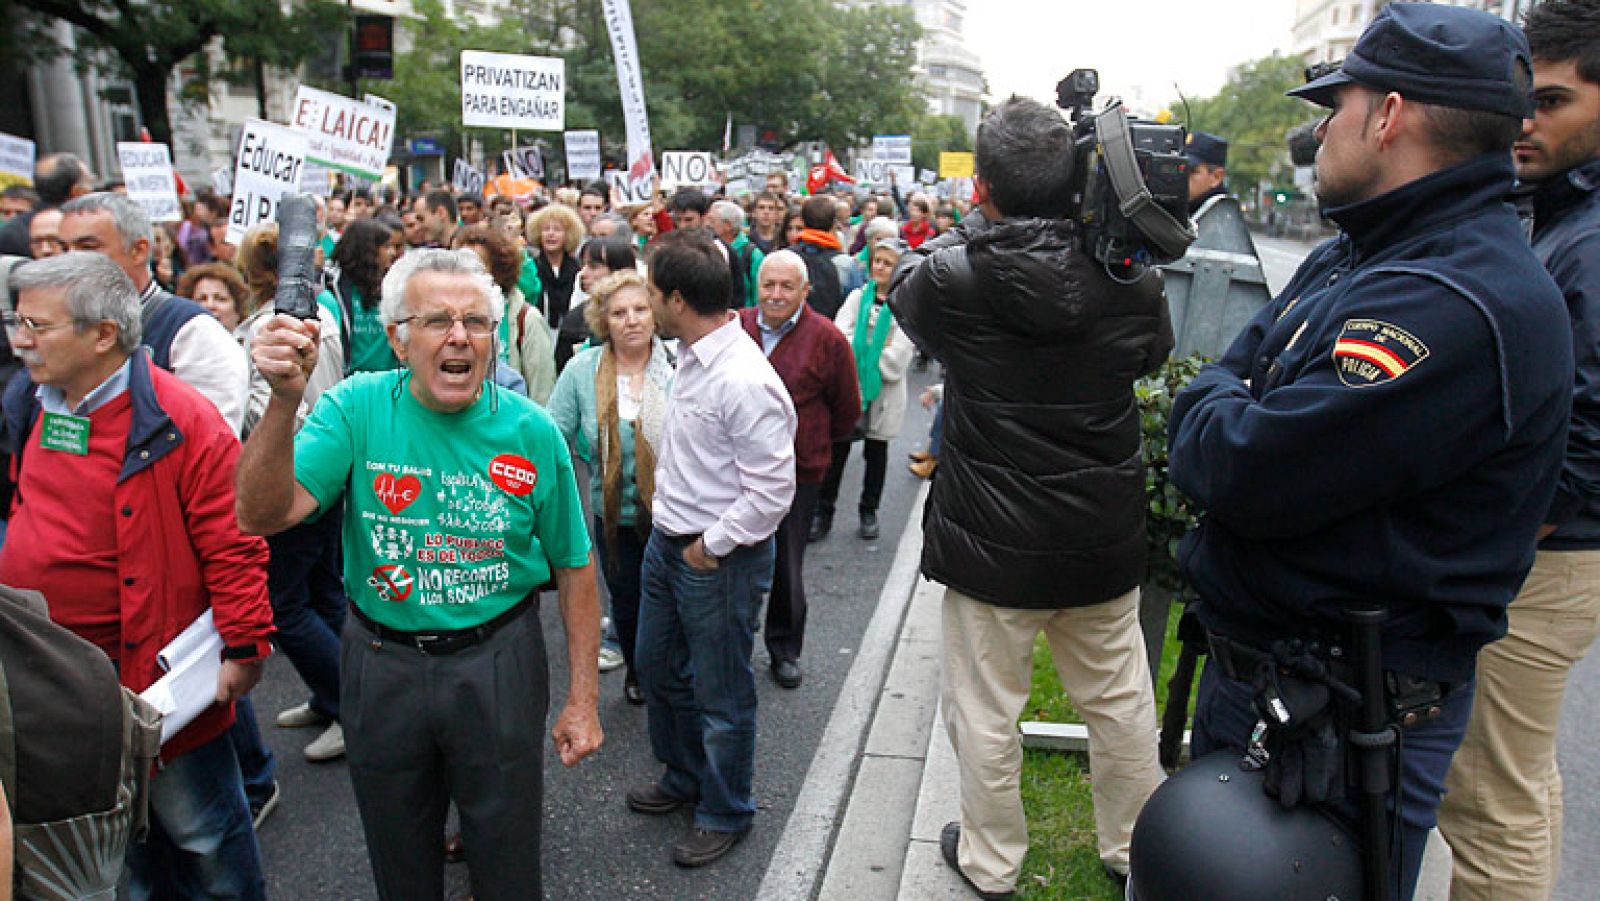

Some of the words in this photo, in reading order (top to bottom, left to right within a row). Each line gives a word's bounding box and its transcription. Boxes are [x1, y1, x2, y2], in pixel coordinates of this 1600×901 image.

[464, 64, 560, 92] PRIVATIZAN
[464, 93, 498, 115] PARA
[500, 95, 559, 119] ENGAÑAR
[241, 132, 302, 184] Educar
[664, 154, 707, 182] NO
[232, 192, 253, 227] al
[387, 463, 401, 473] TU
[492, 461, 536, 485] CCOO
[425, 532, 443, 547] LO
[416, 548, 435, 563] ES
[437, 548, 457, 563] DE
[416, 566, 442, 591] NO
[443, 561, 509, 587] RECORTES
[427, 592, 443, 606] LOS
